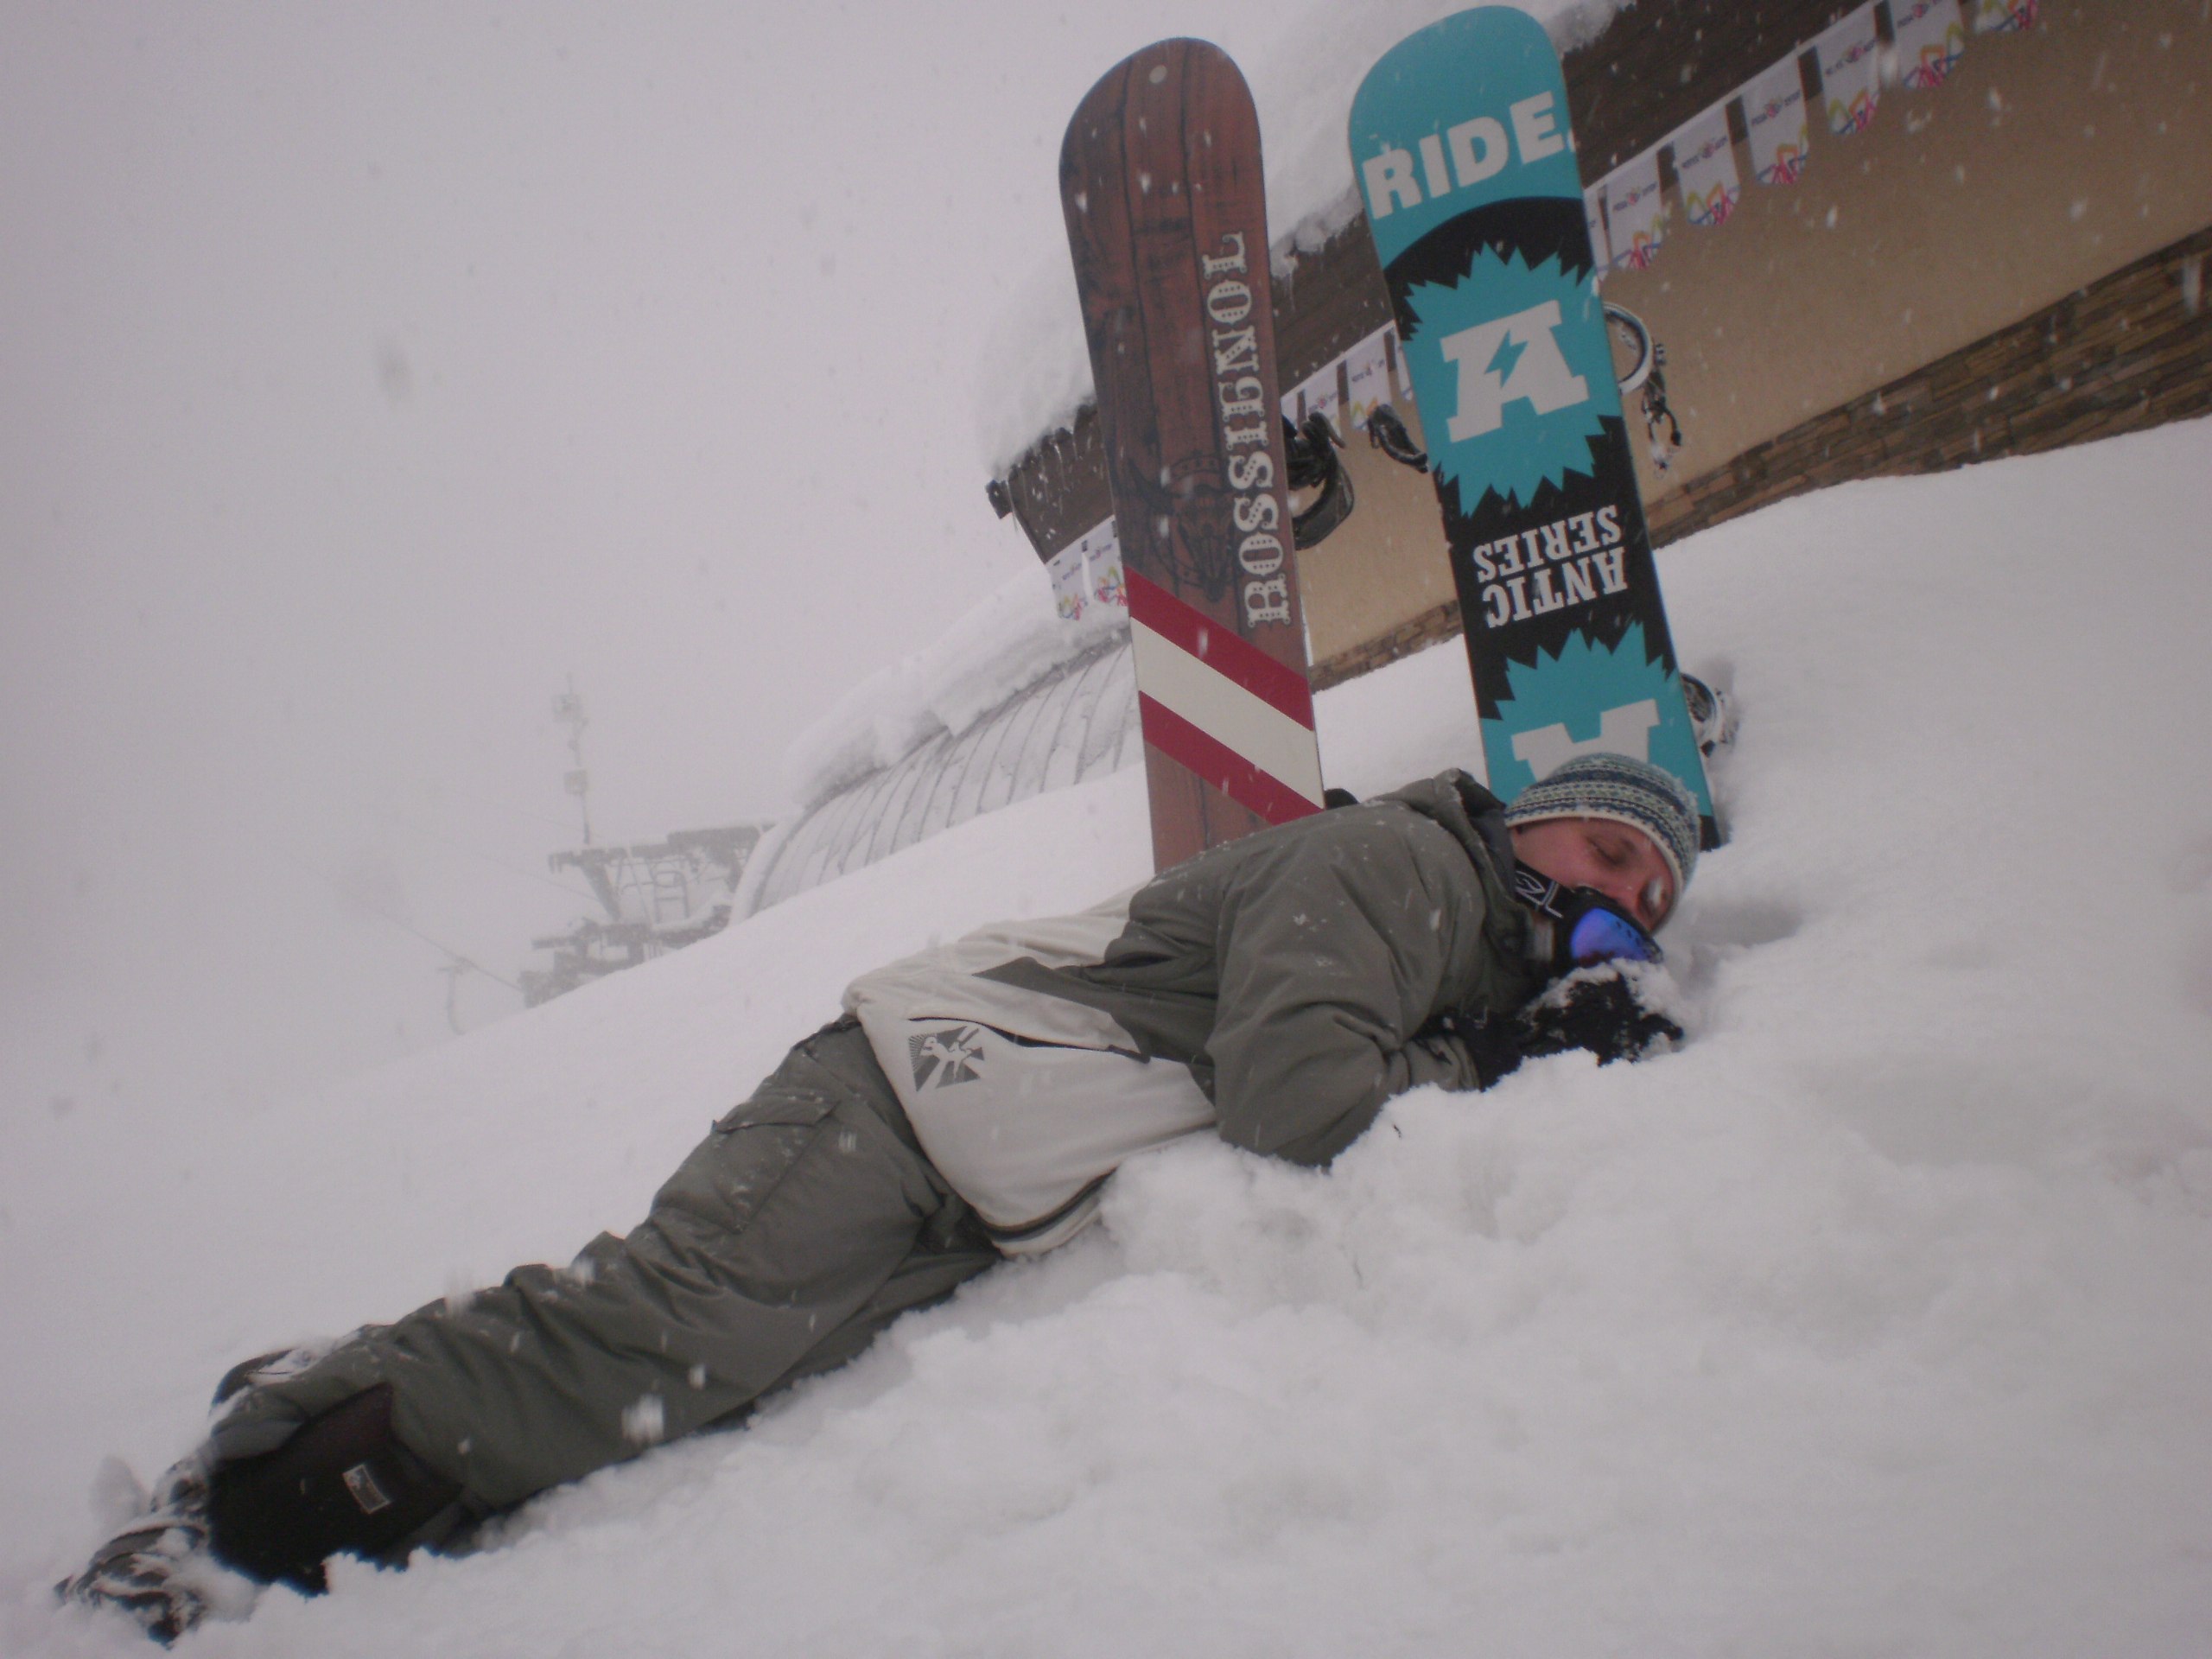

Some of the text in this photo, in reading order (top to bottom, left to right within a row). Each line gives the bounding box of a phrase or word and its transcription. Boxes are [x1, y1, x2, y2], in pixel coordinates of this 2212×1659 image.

[1363, 91, 1564, 219] RIDE
[1204, 231, 1290, 627] ROSSIGNOL
[1473, 505, 1621, 582] SERIES
[1482, 547, 1628, 627] ANTIC
